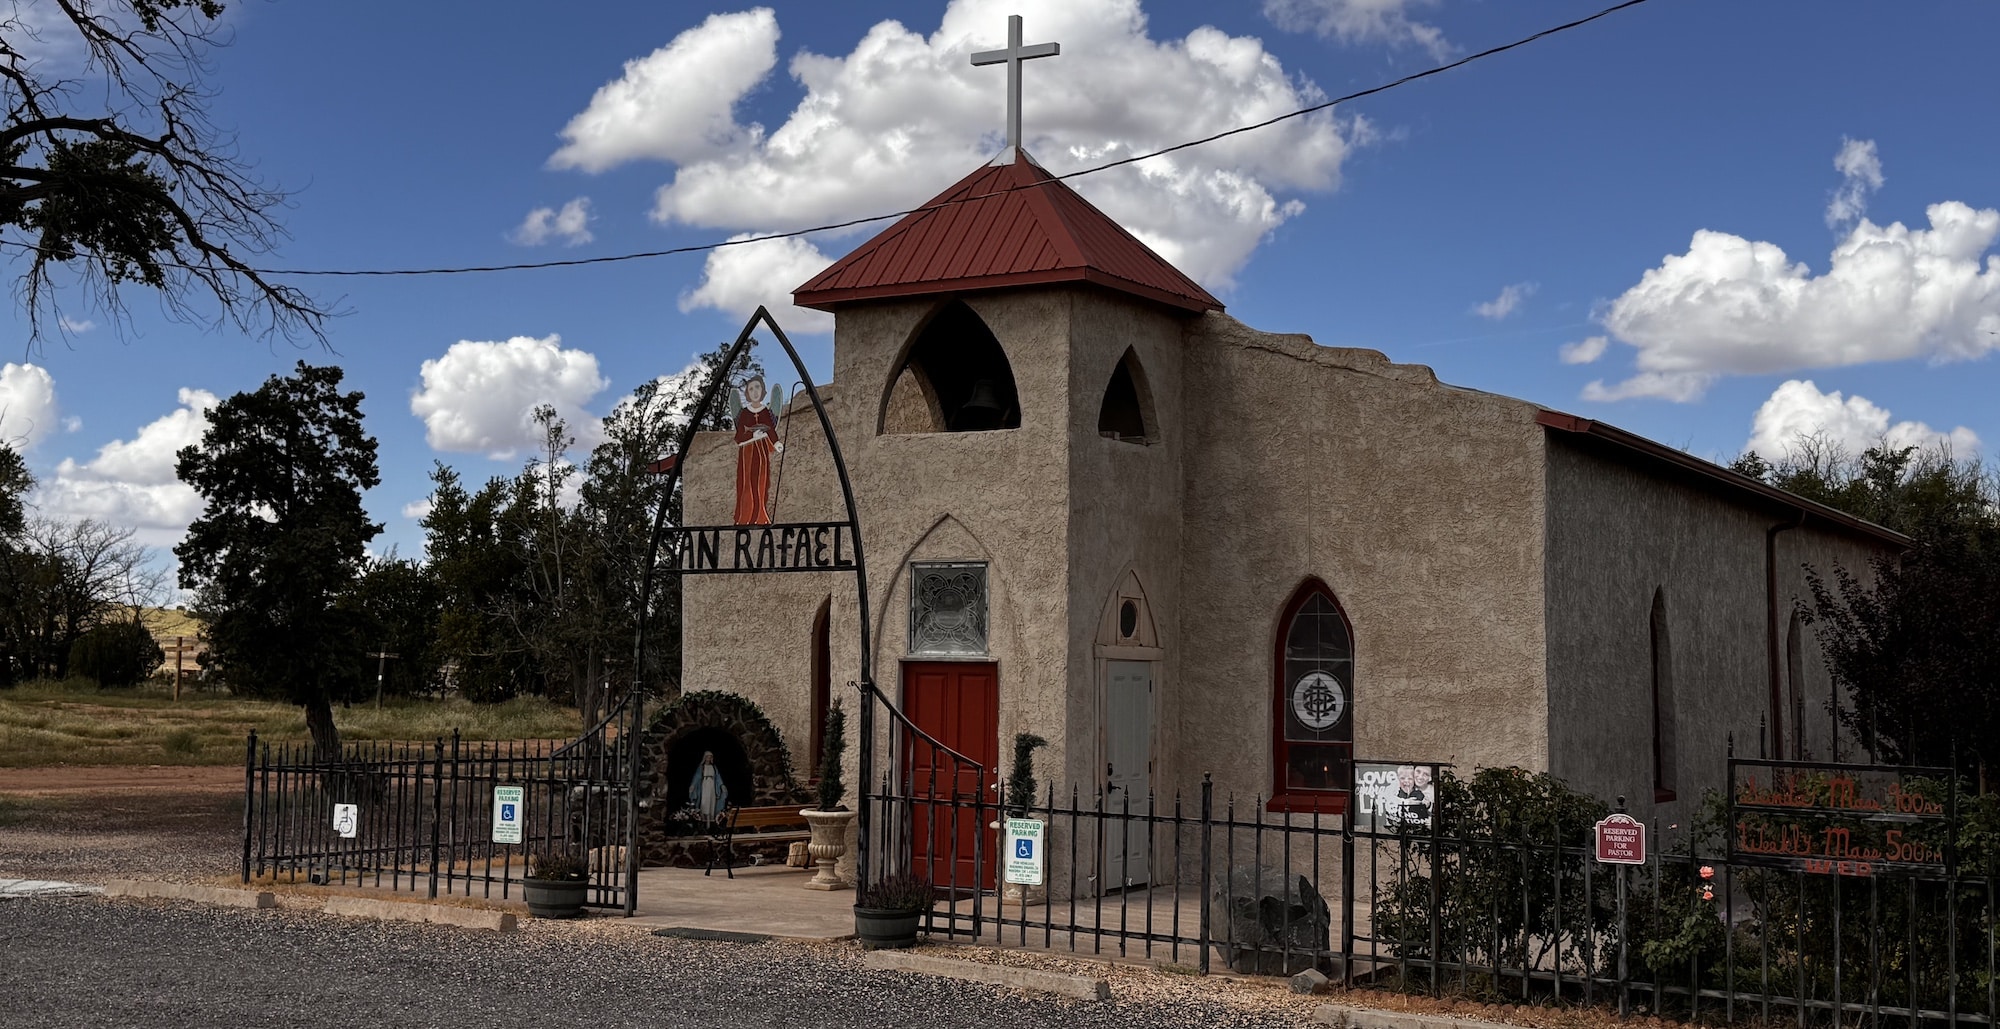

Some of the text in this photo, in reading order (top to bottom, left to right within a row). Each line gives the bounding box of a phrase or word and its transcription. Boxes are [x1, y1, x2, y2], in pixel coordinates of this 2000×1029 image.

[734, 527, 853, 569] RAFAEL
[1825, 778, 1884, 811] Mass
[1012, 829, 1038, 837] PARKING
[1736, 822, 1812, 856] Weekly
[1820, 826, 1882, 860] Mass
